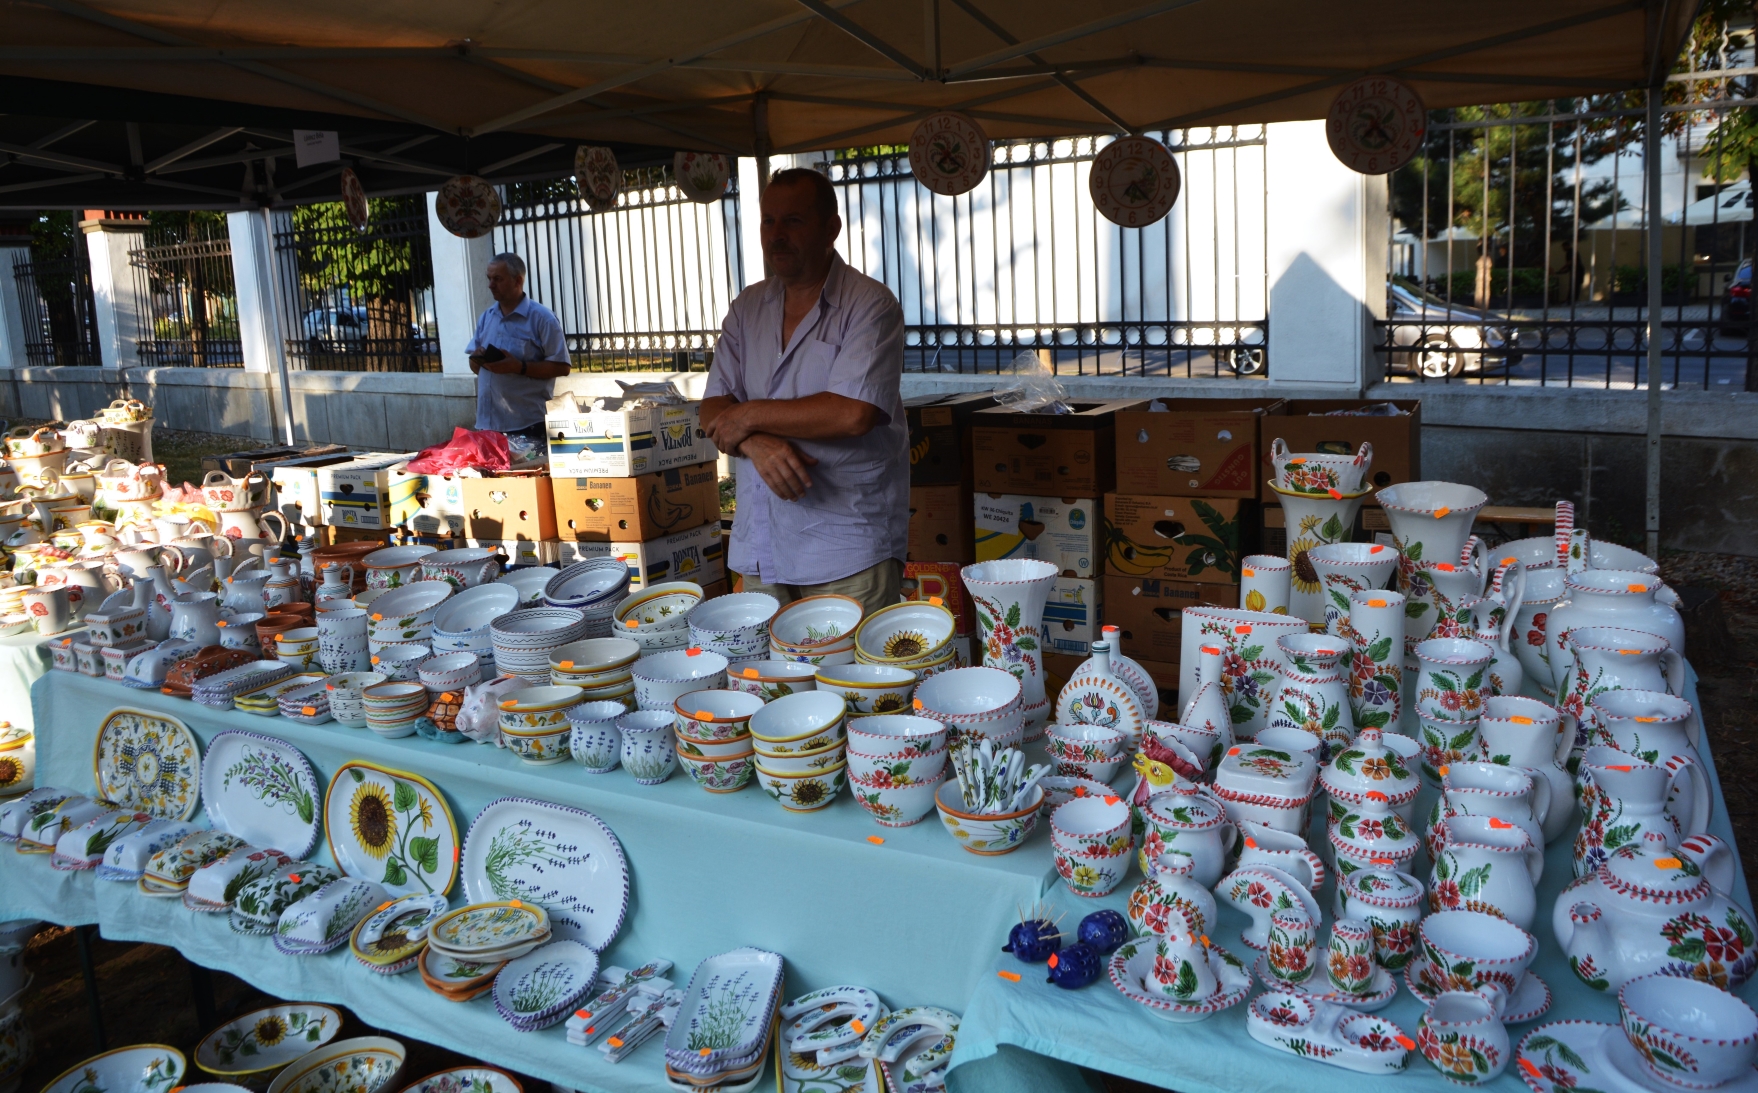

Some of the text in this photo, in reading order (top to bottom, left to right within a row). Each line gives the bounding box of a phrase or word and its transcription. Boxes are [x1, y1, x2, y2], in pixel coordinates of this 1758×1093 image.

[1352, 85, 1364, 100] 11
[1370, 81, 1387, 95] 12
[1393, 85, 1400, 99] 1
[1336, 99, 1352, 114] 10
[1406, 99, 1416, 114] 2
[924, 122, 934, 134] 11
[937, 117, 951, 129] 12
[956, 121, 961, 131] 1
[1333, 119, 1343, 133] 9
[1409, 119, 1418, 133] 3
[914, 134, 926, 147] 10
[968, 131, 975, 143] 2
[1127, 142, 1143, 155] 12
[1338, 137, 1346, 152] 8
[1402, 138, 1411, 152] 4
[913, 151, 921, 163] 9
[973, 147, 980, 159] 3
[1111, 145, 1122, 159] 11
[1148, 147, 1154, 159] 1
[1351, 152, 1360, 165] 7
[1390, 152, 1398, 165] 5
[970, 164, 978, 175] 4
[1098, 158, 1112, 172] 10
[1161, 159, 1169, 172] 2
[1368, 156, 1377, 171] 6
[920, 166, 927, 179] 8
[932, 178, 939, 189] 7
[947, 181, 954, 193] 6
[963, 175, 969, 187] 5
[1095, 176, 1103, 189] 9
[1163, 177, 1172, 190] 3
[1100, 193, 1108, 206] 8
[1158, 194, 1167, 207] 4
[1112, 207, 1121, 220] 7
[1128, 211, 1136, 224] 6
[1147, 206, 1156, 219] 5
[1013, 417, 1052, 425] BANANAS
[660, 426, 692, 450] BONITA
[674, 454, 697, 463] PREMIUM
[1214, 454, 1244, 485] GÜNSTIG
[590, 481, 612, 489] Bananen
[684, 472, 714, 486] Bananen
[1232, 470, 1248, 487] GUT
[996, 508, 1014, 516] Chiquita
[666, 530, 702, 545] PREMIUM PACK
[672, 545, 700, 572] BONITA
[1164, 587, 1200, 600] Bananen
